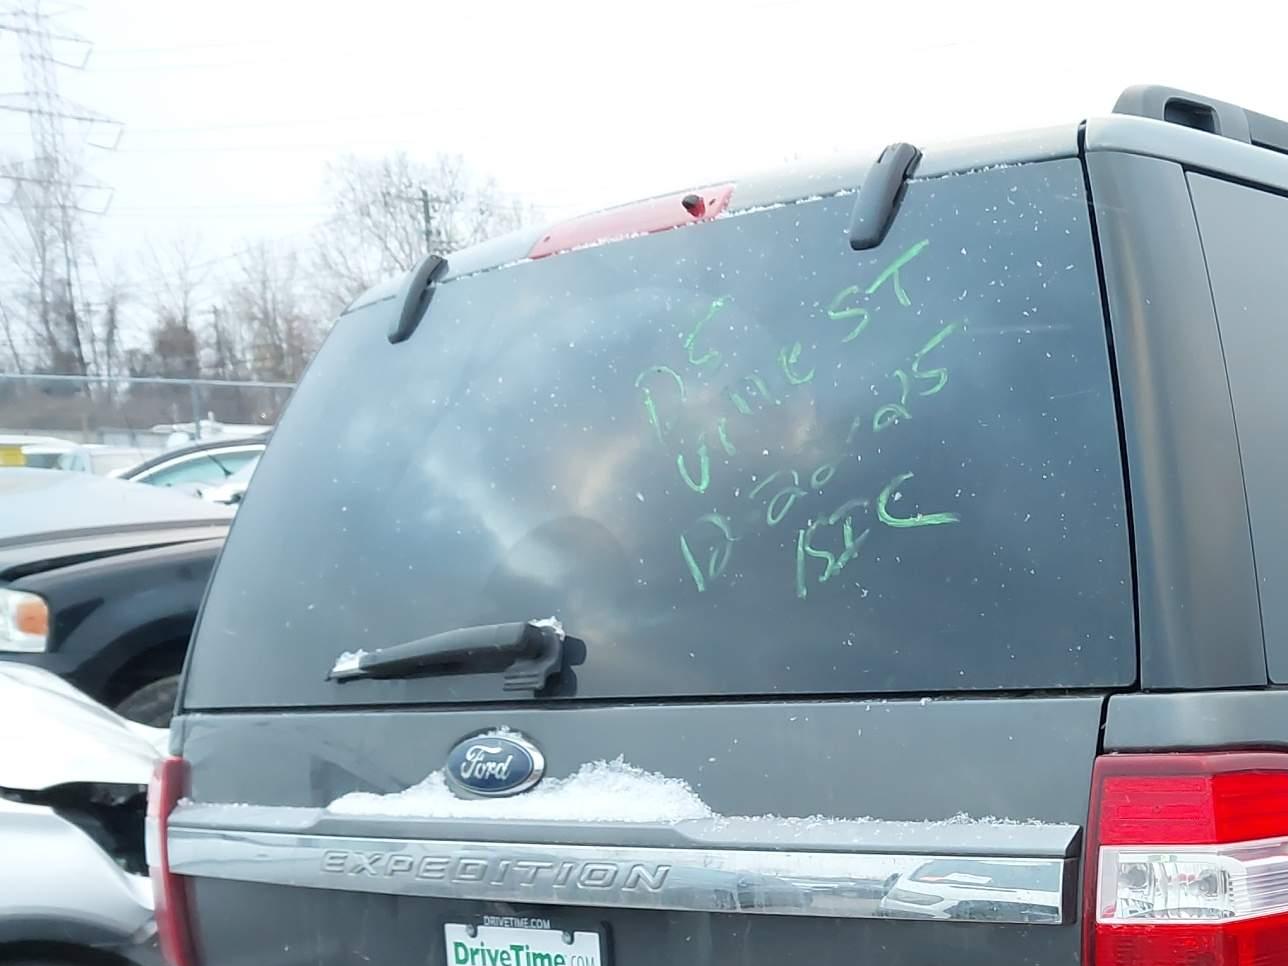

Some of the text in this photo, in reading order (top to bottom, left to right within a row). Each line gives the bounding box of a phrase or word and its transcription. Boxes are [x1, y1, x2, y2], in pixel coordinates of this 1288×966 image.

[460, 744, 513, 779] Ford
[319, 849, 672, 892] EXPEDITION
[483, 915, 550, 929] DRIVETIME.COM
